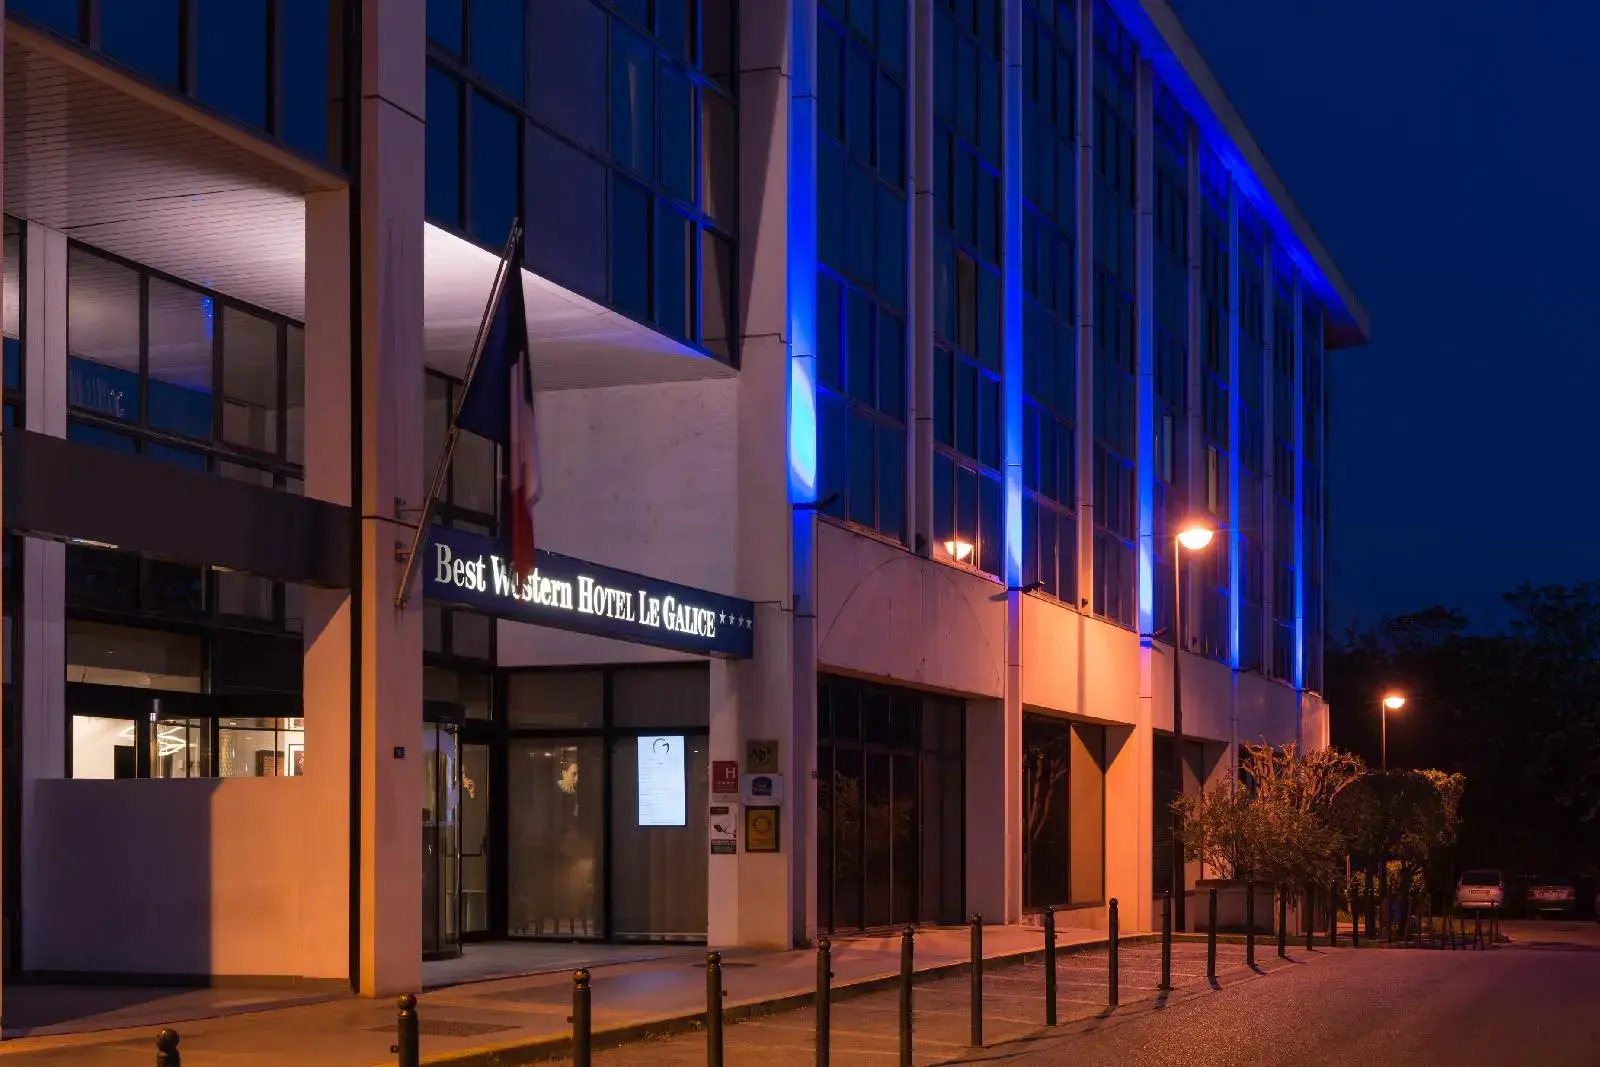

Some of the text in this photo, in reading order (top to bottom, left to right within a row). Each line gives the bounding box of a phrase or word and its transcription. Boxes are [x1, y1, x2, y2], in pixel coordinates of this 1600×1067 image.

[434, 542, 486, 592] Best
[577, 575, 635, 622] HOTEL
[638, 590, 660, 627] LE
[662, 595, 716, 638] GALICE
[725, 767, 736, 779] H
